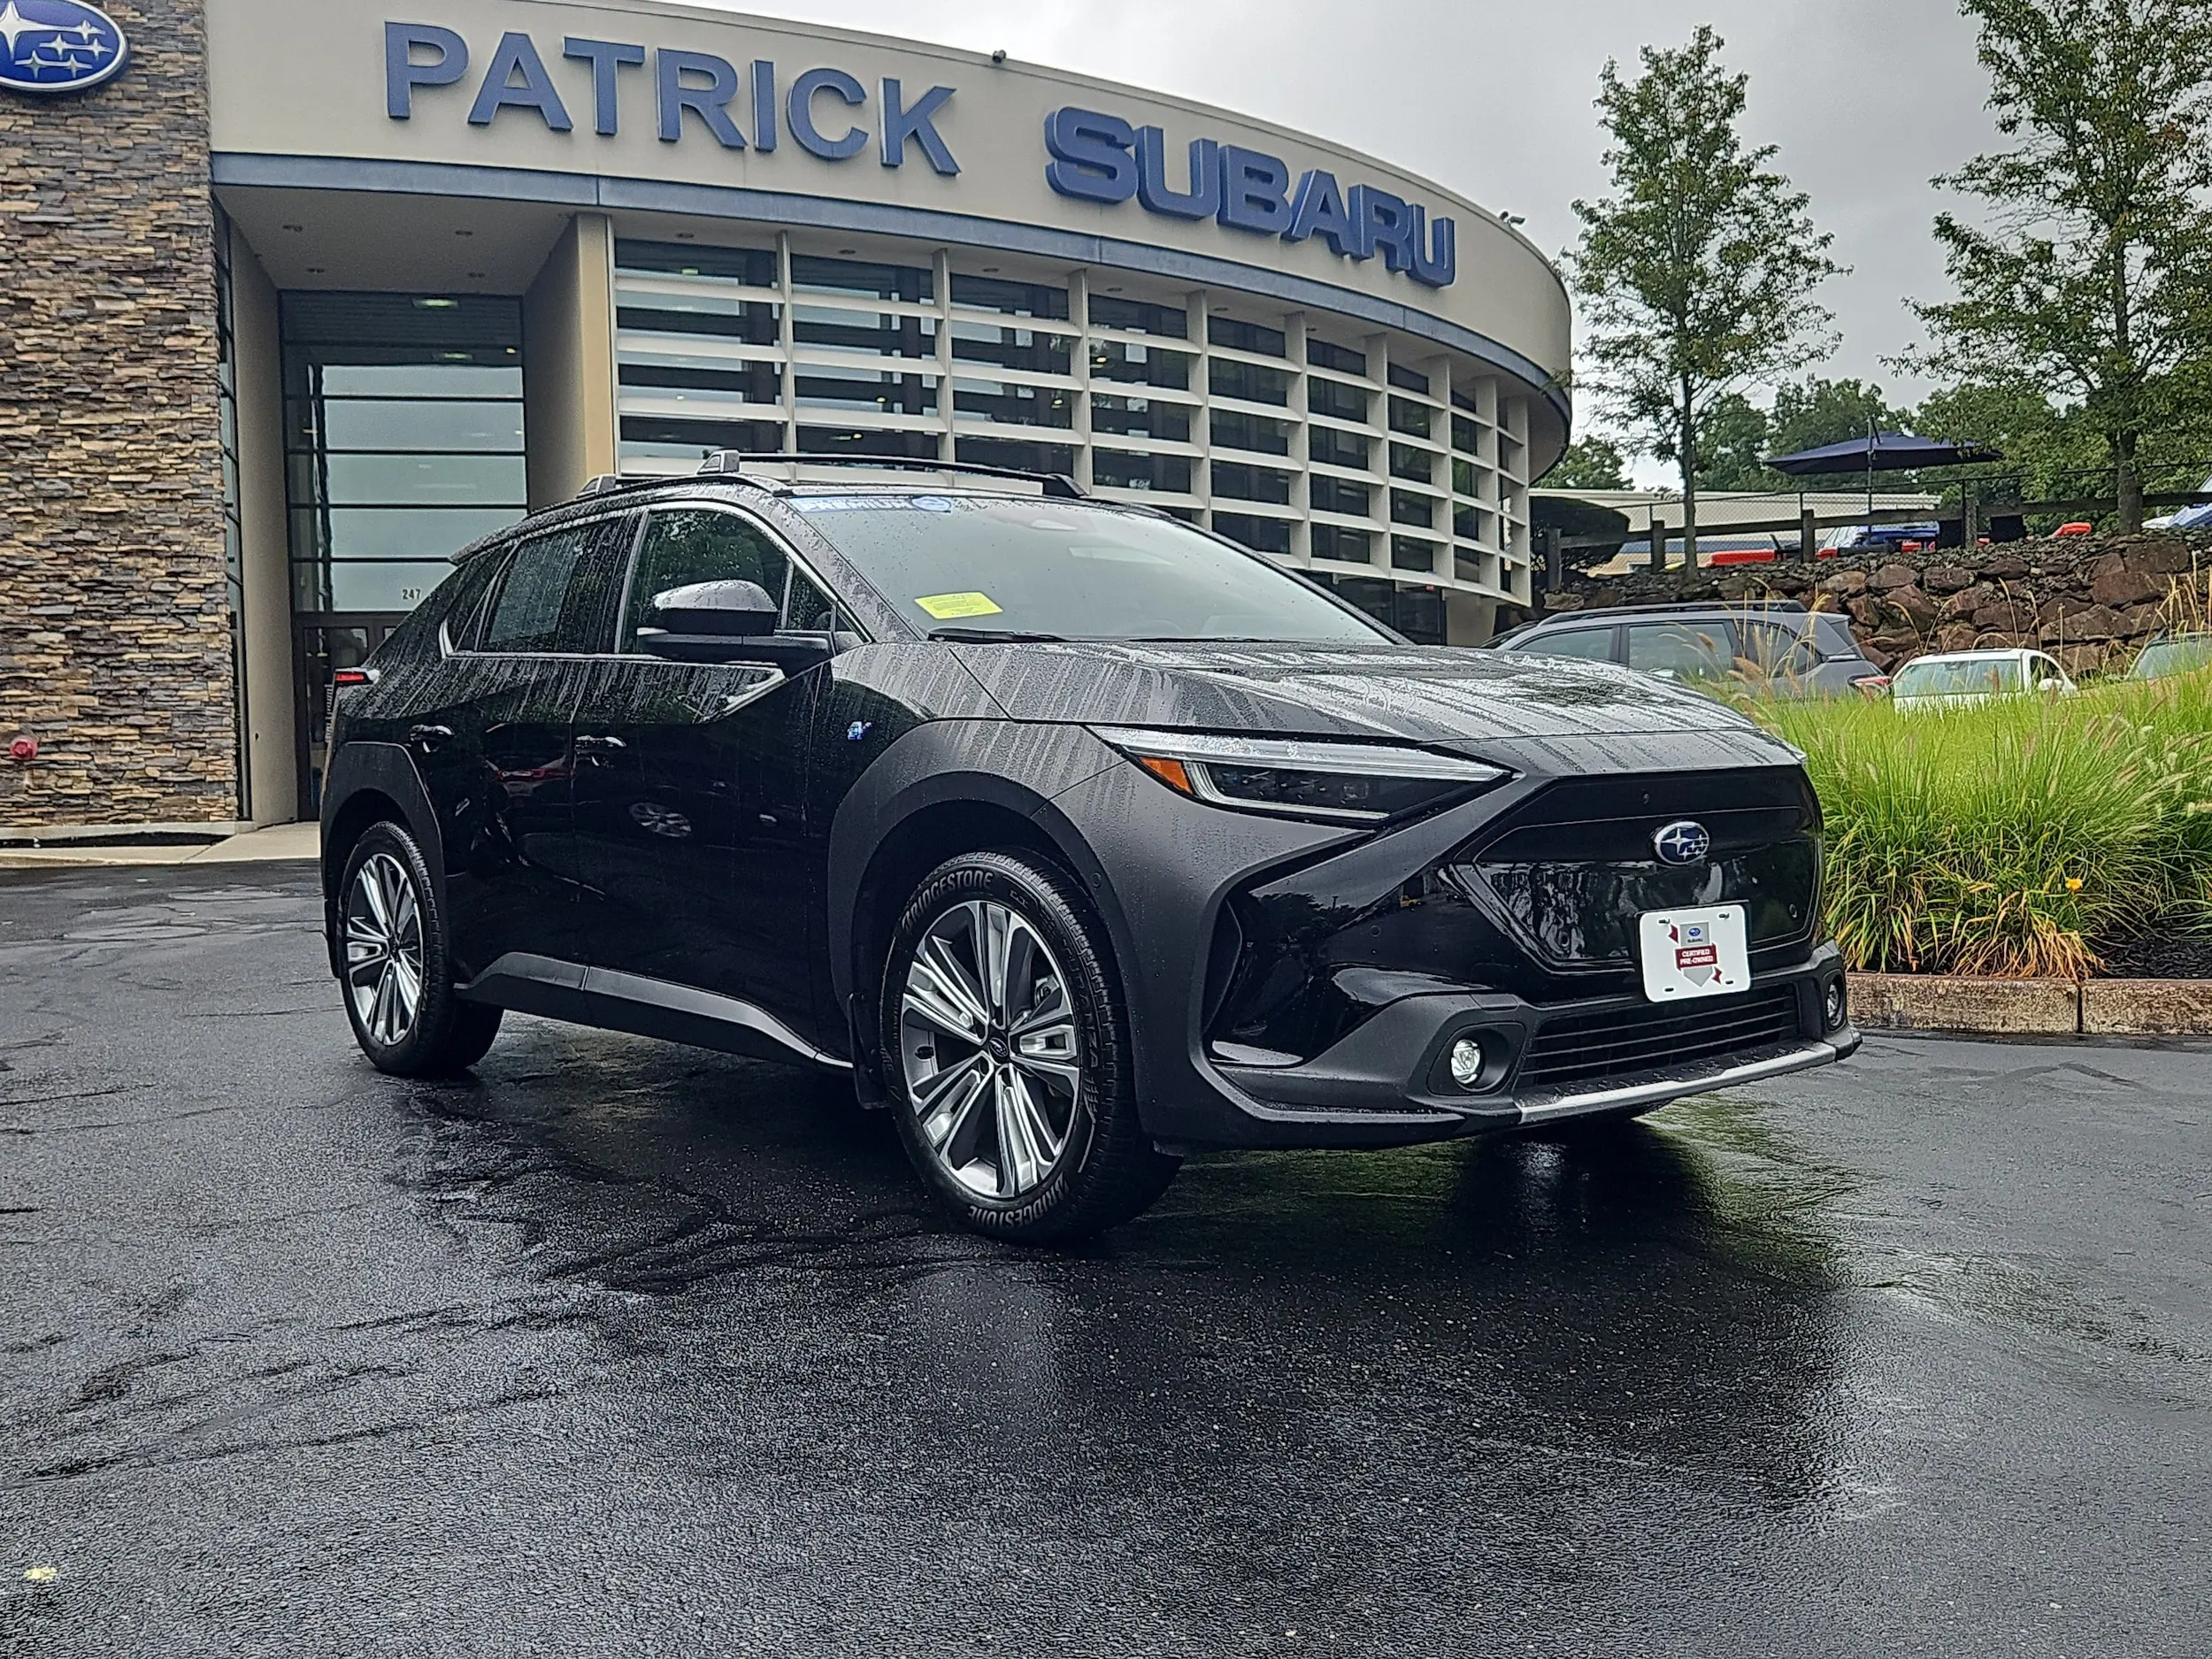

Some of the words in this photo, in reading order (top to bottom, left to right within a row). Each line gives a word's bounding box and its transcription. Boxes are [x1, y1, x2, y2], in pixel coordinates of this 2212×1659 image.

[384, 20, 962, 178] PATRICK
[1045, 105, 1455, 288] SUBARU
[402, 588, 421, 600] 247
[901, 869, 995, 934] BRIDGESTONE
[1681, 949, 1710, 957] CERTIFIED
[1679, 956, 1714, 965] PRE-OWNED
